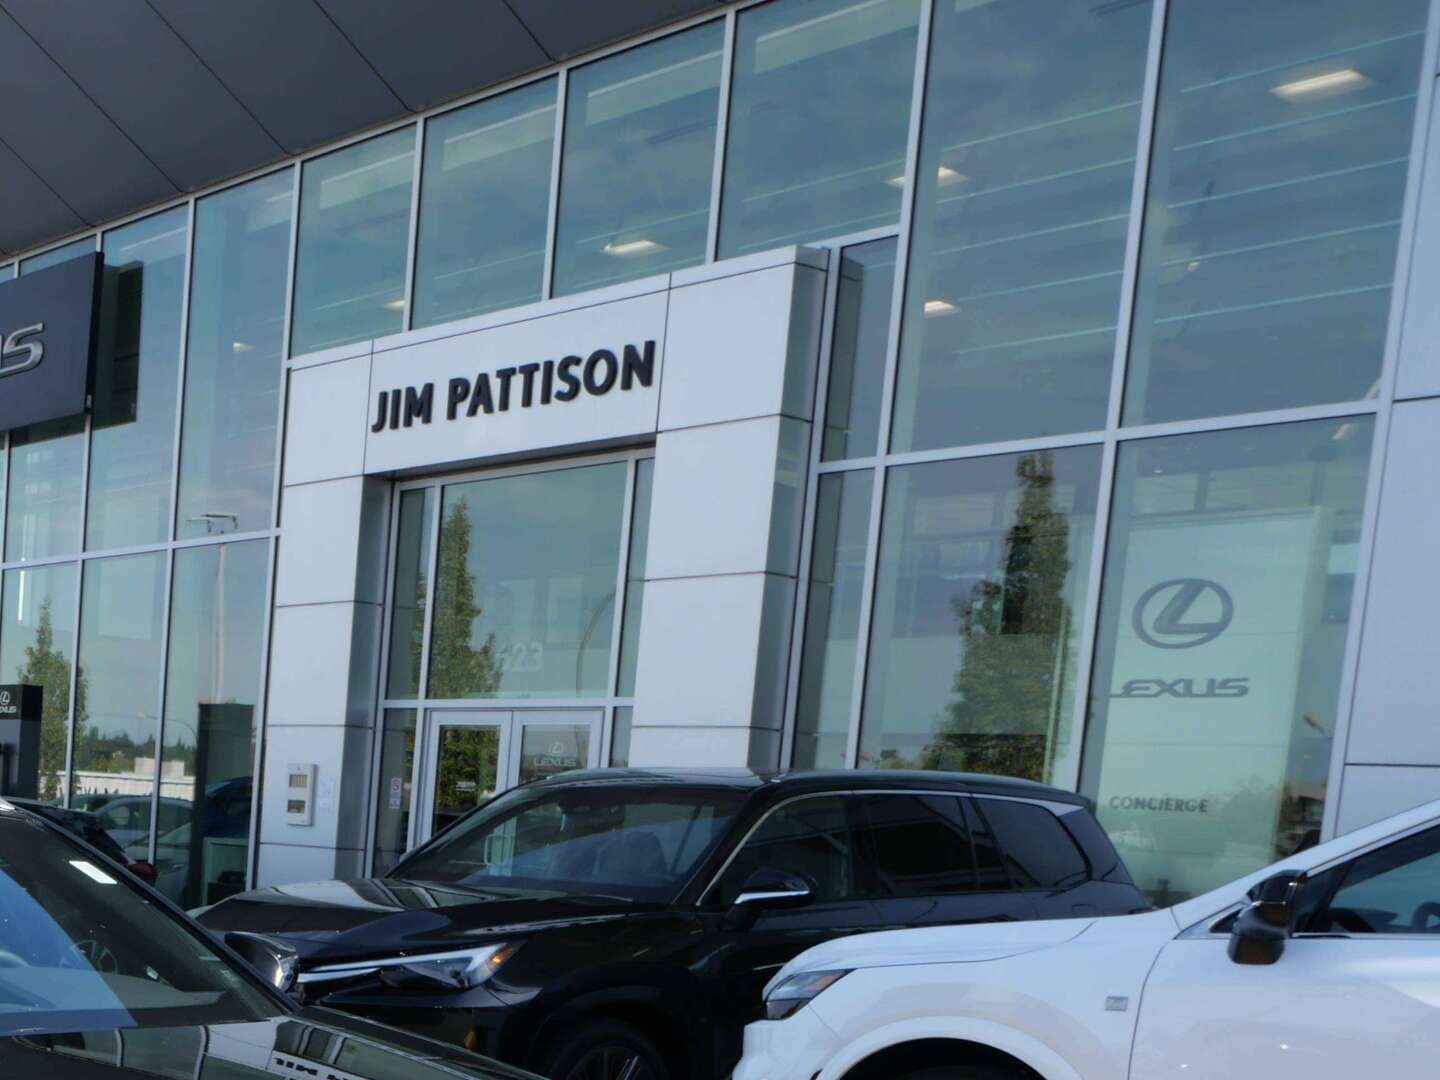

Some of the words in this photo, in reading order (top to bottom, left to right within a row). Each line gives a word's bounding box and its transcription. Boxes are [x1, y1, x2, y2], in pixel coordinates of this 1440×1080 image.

[371, 382, 435, 433] JIM
[446, 340, 656, 421] PATTISON
[1111, 796, 1209, 813] CONCIERGE
